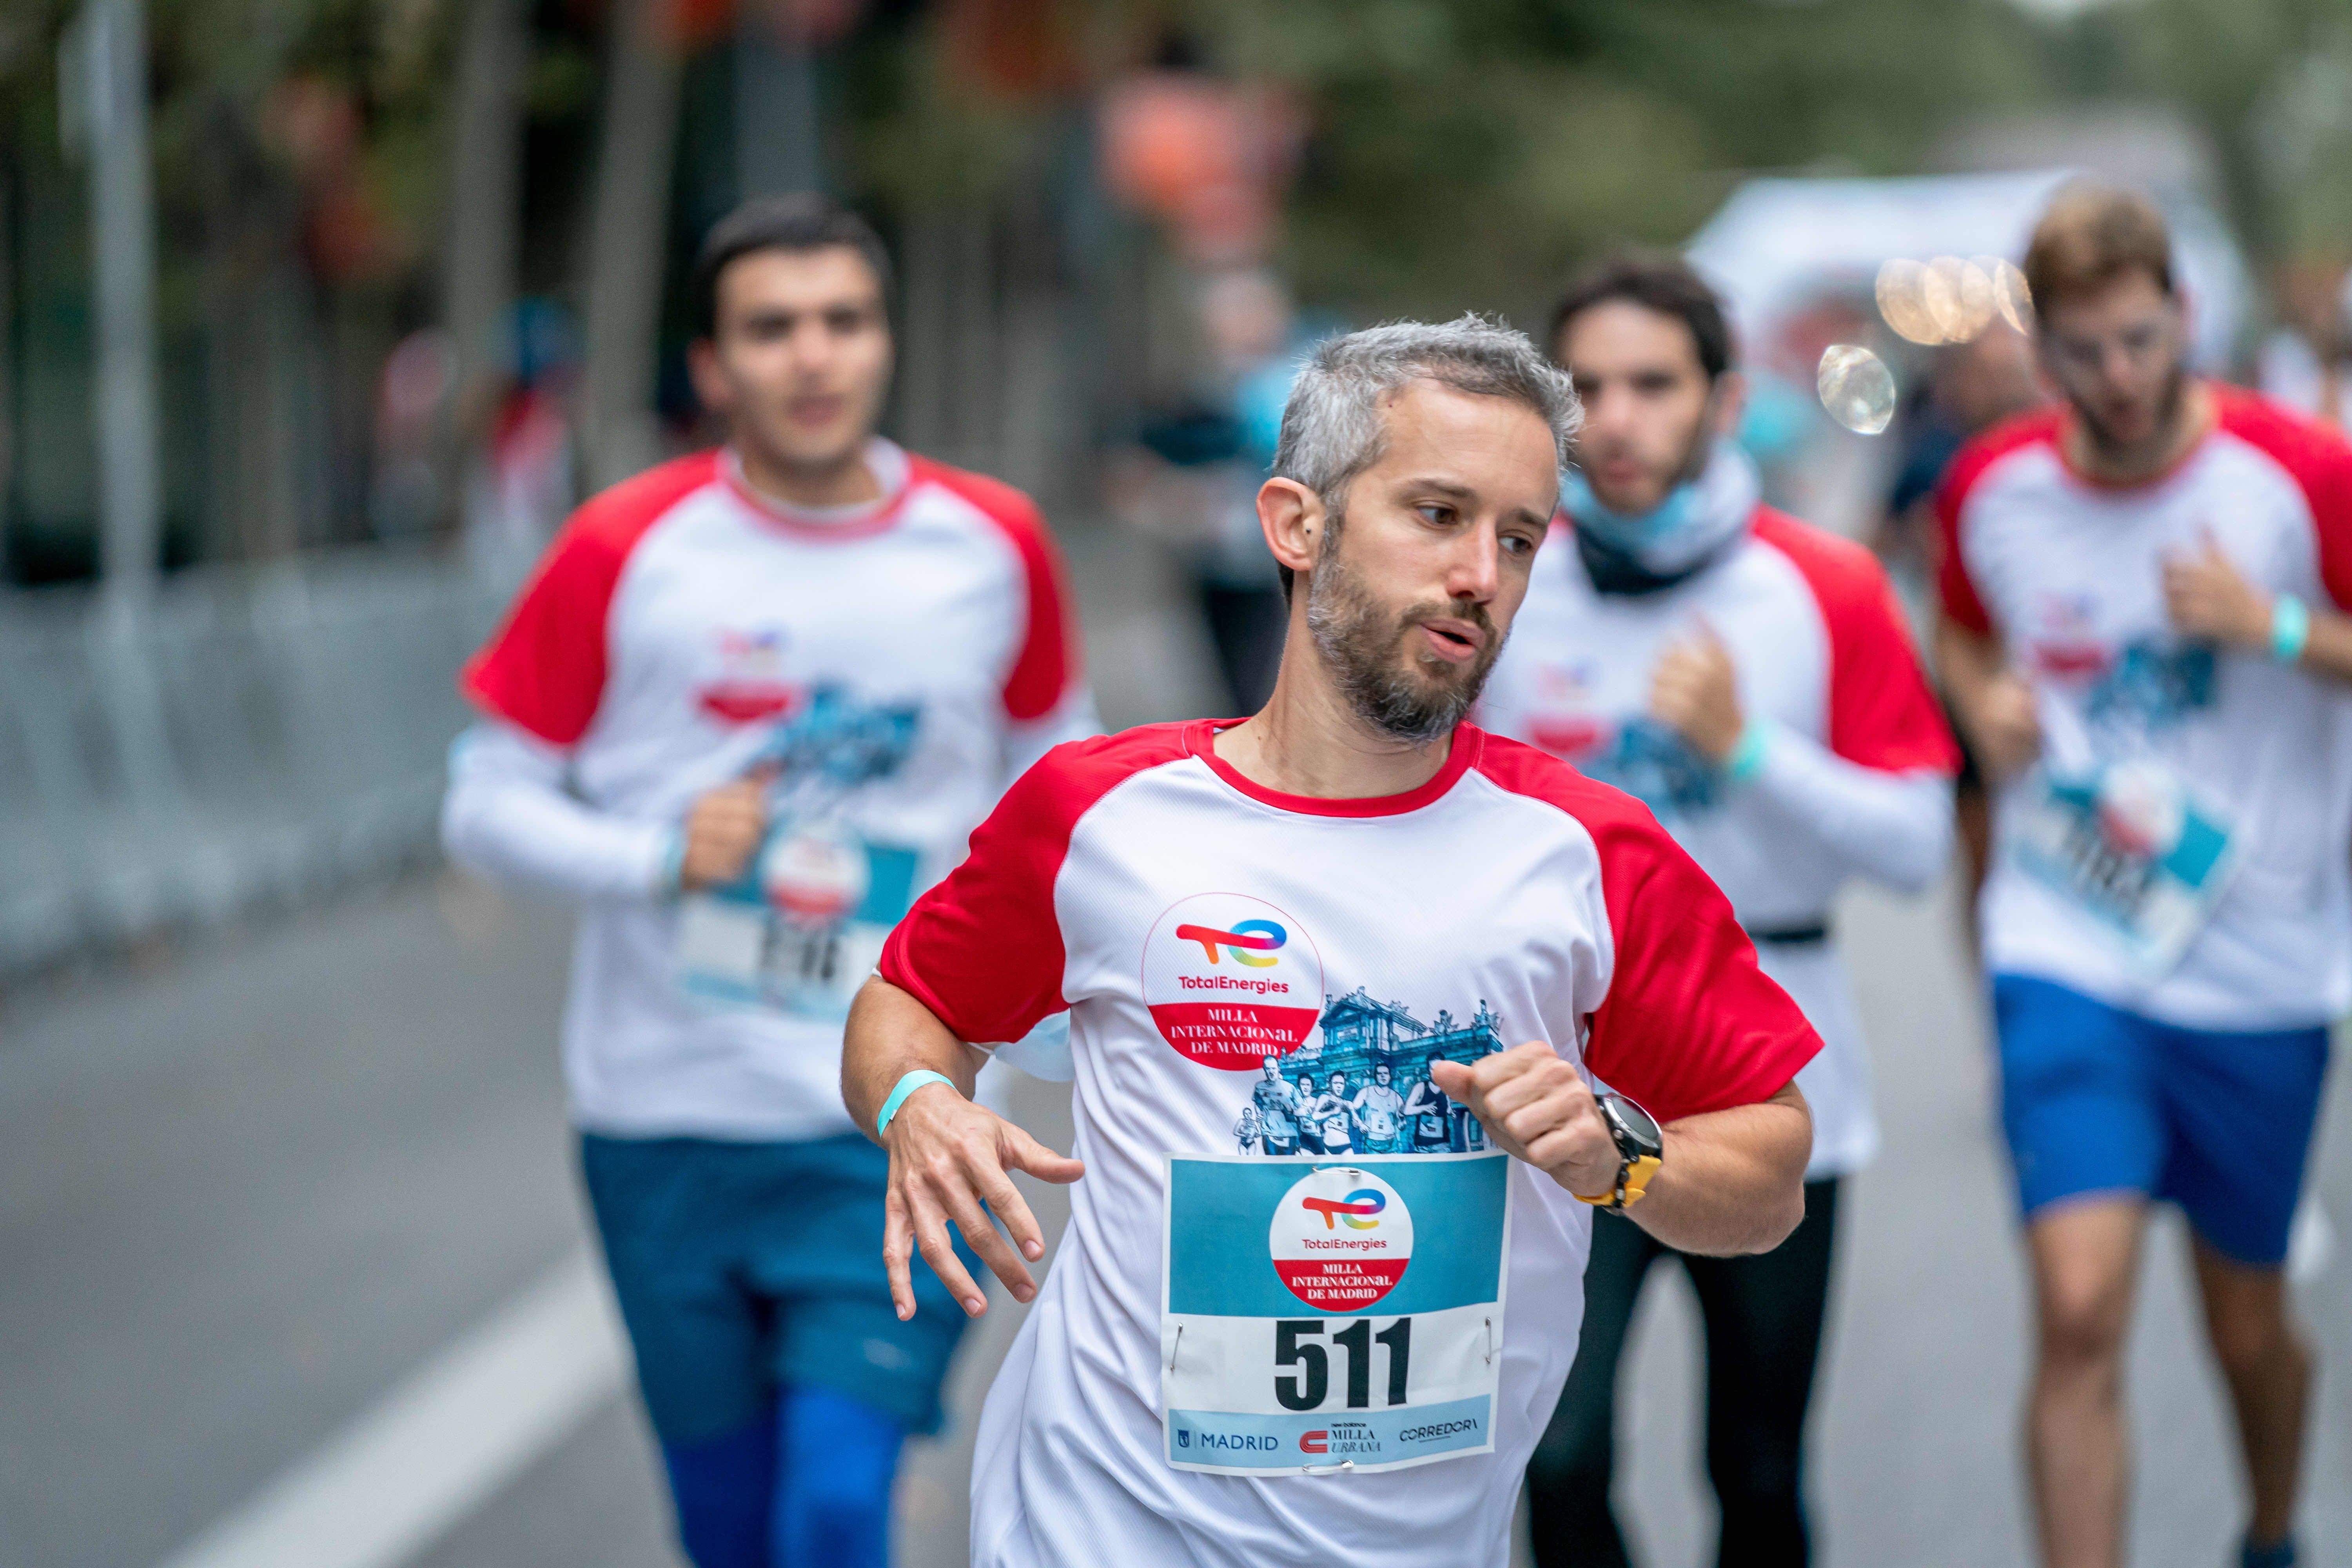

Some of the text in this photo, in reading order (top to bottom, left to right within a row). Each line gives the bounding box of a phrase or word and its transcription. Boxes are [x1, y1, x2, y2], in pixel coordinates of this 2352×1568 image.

[1178, 976, 1289, 994] TotalEnergies
[1208, 1009, 1258, 1023] MILLA
[1192, 1041, 1278, 1056] DE MADRID
[1302, 1238, 1387, 1250] TotalEnergies
[1323, 1264, 1363, 1274] MILLA
[1307, 1288, 1377, 1299] DE MADRID
[1275, 1317, 1411, 1411] 511
[1201, 1433, 1278, 1450] MADRID
[1332, 1430, 1376, 1440] MILLA
[1332, 1441, 1381, 1453] URBANA
